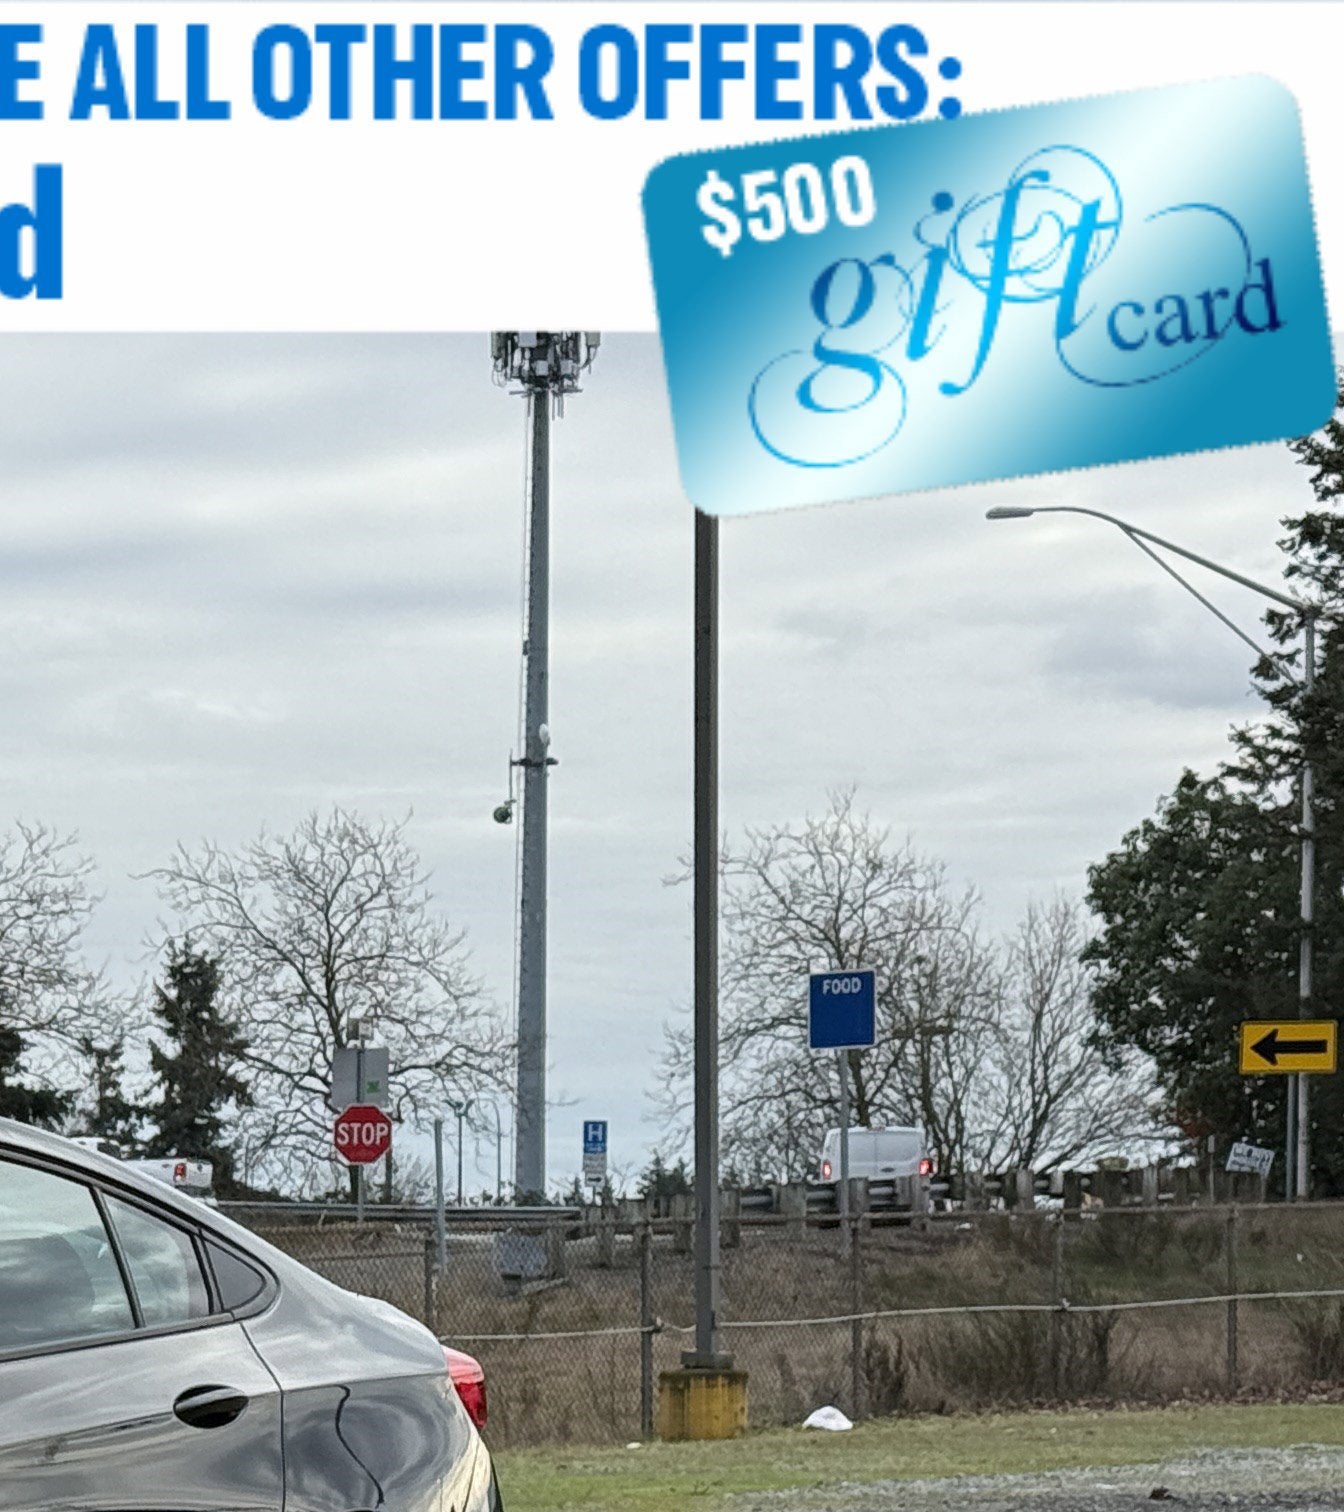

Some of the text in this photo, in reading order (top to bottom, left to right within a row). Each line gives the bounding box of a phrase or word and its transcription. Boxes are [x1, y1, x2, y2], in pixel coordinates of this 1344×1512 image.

[822, 976, 862, 995] FOOD
[336, 1121, 389, 1146] STOP
[587, 1123, 603, 1142] H
